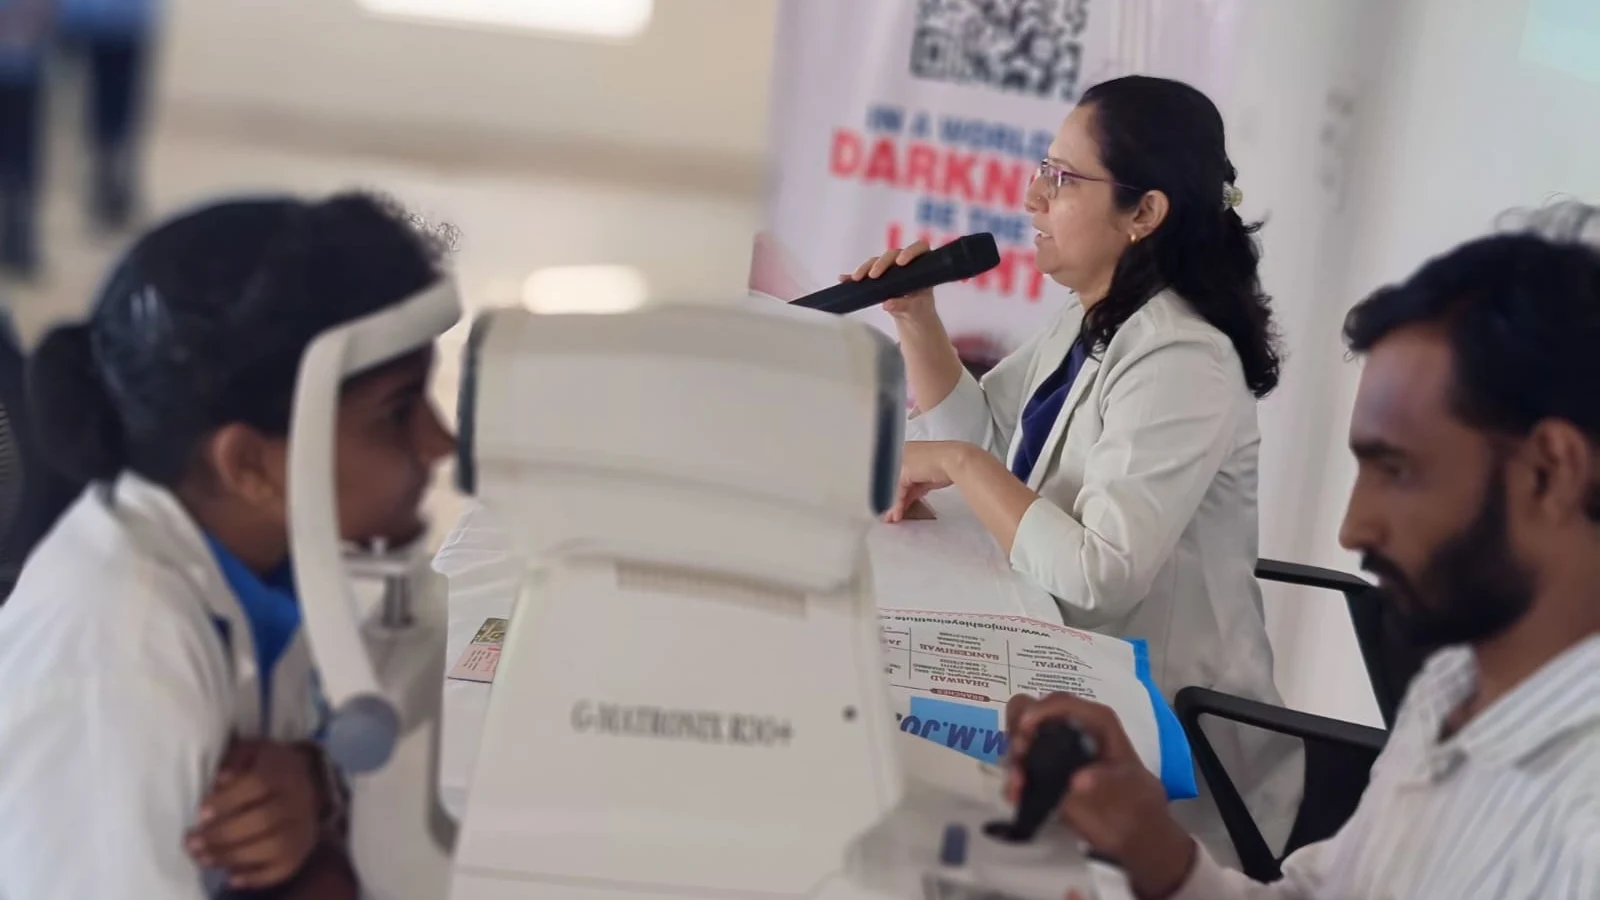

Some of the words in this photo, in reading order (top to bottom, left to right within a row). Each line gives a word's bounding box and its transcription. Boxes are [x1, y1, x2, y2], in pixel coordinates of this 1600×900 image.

[867, 104, 905, 136] IN
[910, 109, 933, 138] A
[828, 127, 1037, 209] DARKN
[916, 197, 955, 231] BE
[930, 675, 990, 688] DHARWAD
[936, 689, 985, 702] BRANCHES
